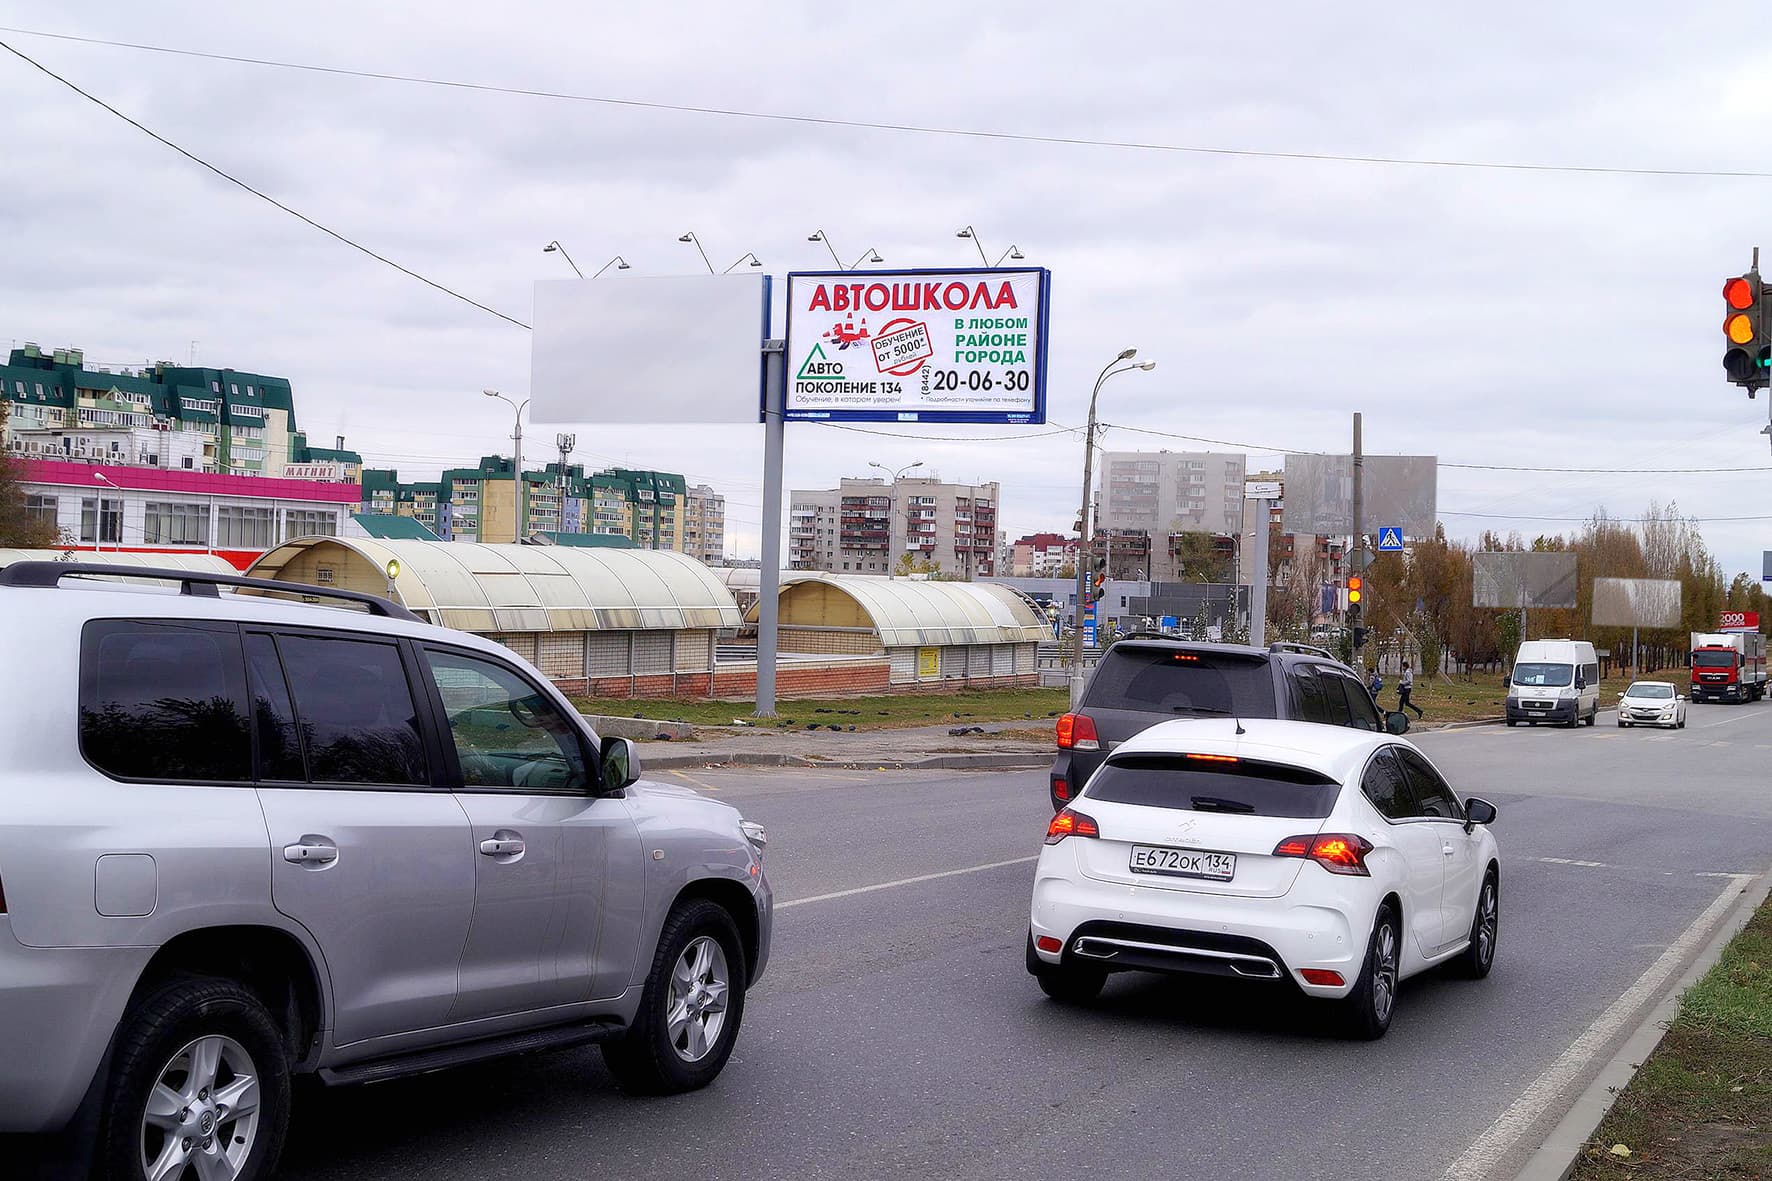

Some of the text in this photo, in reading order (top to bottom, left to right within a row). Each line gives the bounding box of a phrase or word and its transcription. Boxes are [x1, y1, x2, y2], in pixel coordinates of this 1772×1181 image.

[808, 281, 1018, 312] АВТОШКОЛА
[955, 317, 1028, 329] В ЛЮБОМ
[875, 326, 925, 350] ОБУЧЕНИЕ
[955, 331, 1027, 347] РАЙОНЕ
[955, 350, 1026, 365] ГОРОДА
[807, 362, 843, 375] АВТО
[920, 364, 932, 395] (8442)
[933, 370, 1030, 391] 20-06-30
[795, 381, 902, 394] ПОКОЛЕНИЕ 134
[795, 395, 834, 404] Обучение,
[840, 396, 872, 404] котором
[873, 395, 901, 404] уверен!
[285, 467, 333, 477] МАГНИТ
[1205, 854, 1231, 870] 134
